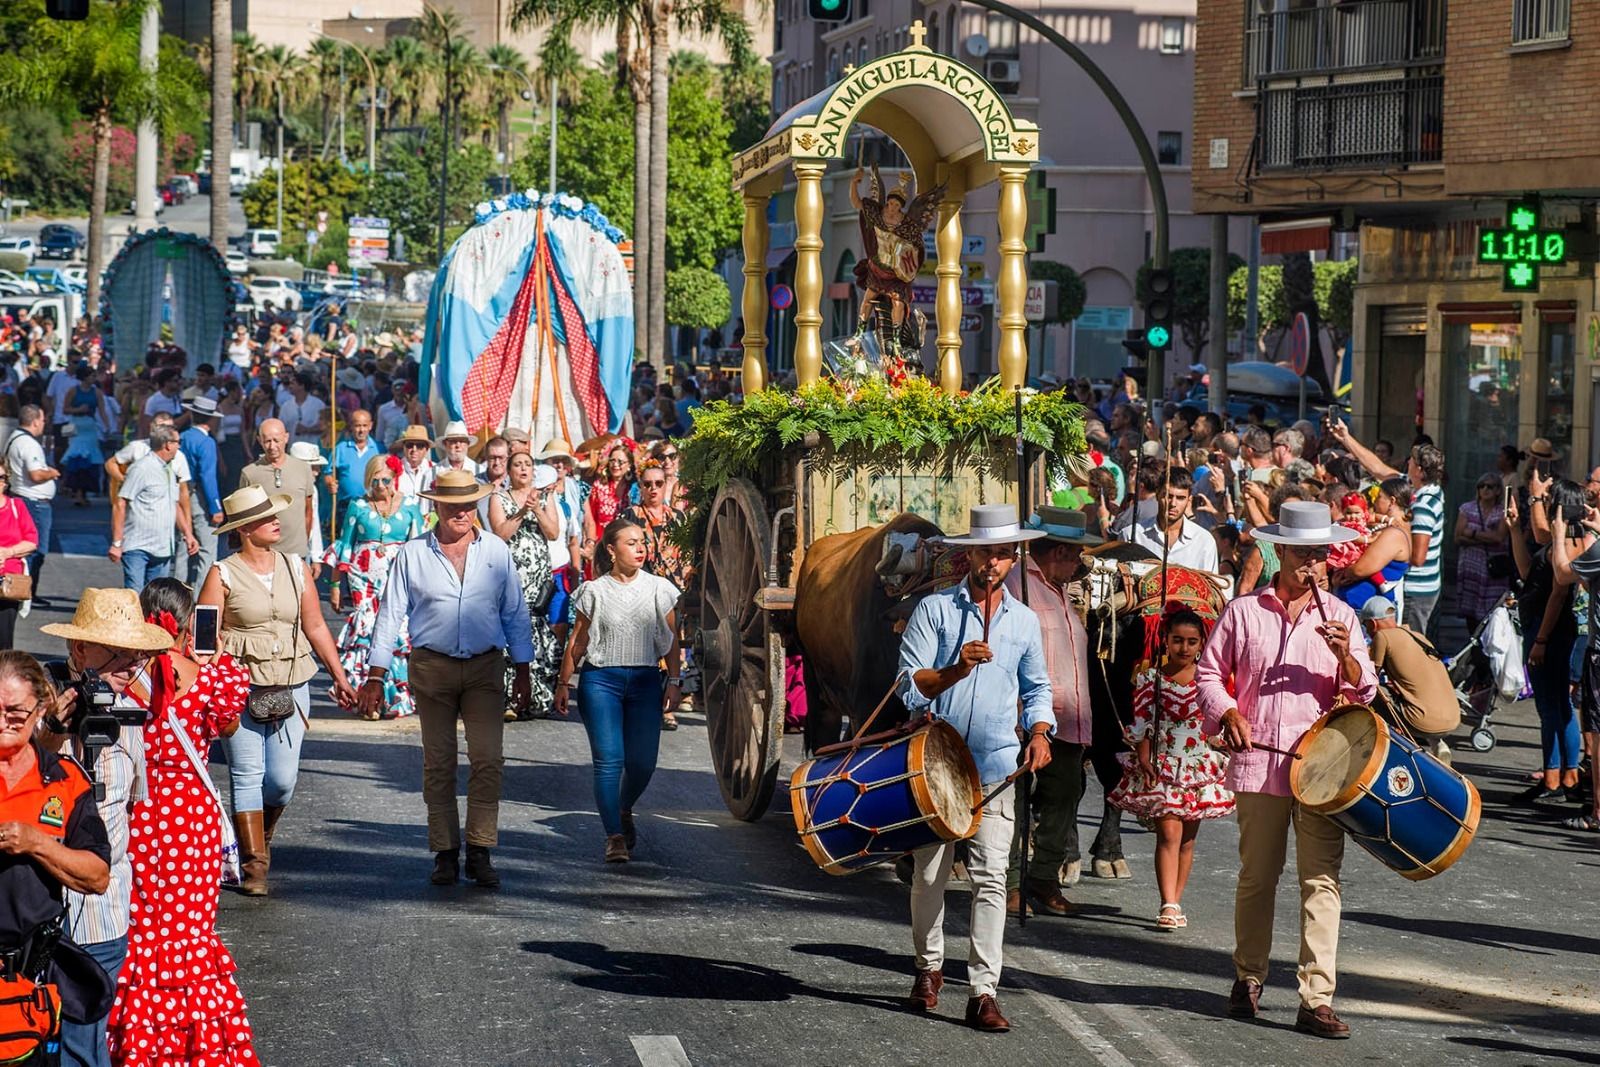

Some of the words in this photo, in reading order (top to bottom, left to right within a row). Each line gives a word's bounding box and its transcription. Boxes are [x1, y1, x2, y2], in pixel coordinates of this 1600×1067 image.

[817, 107, 848, 158] SAN
[836, 58, 923, 112] MIGUEL
[921, 60, 1011, 161] ARCANGEL
[1481, 232, 1565, 261] 11:10
